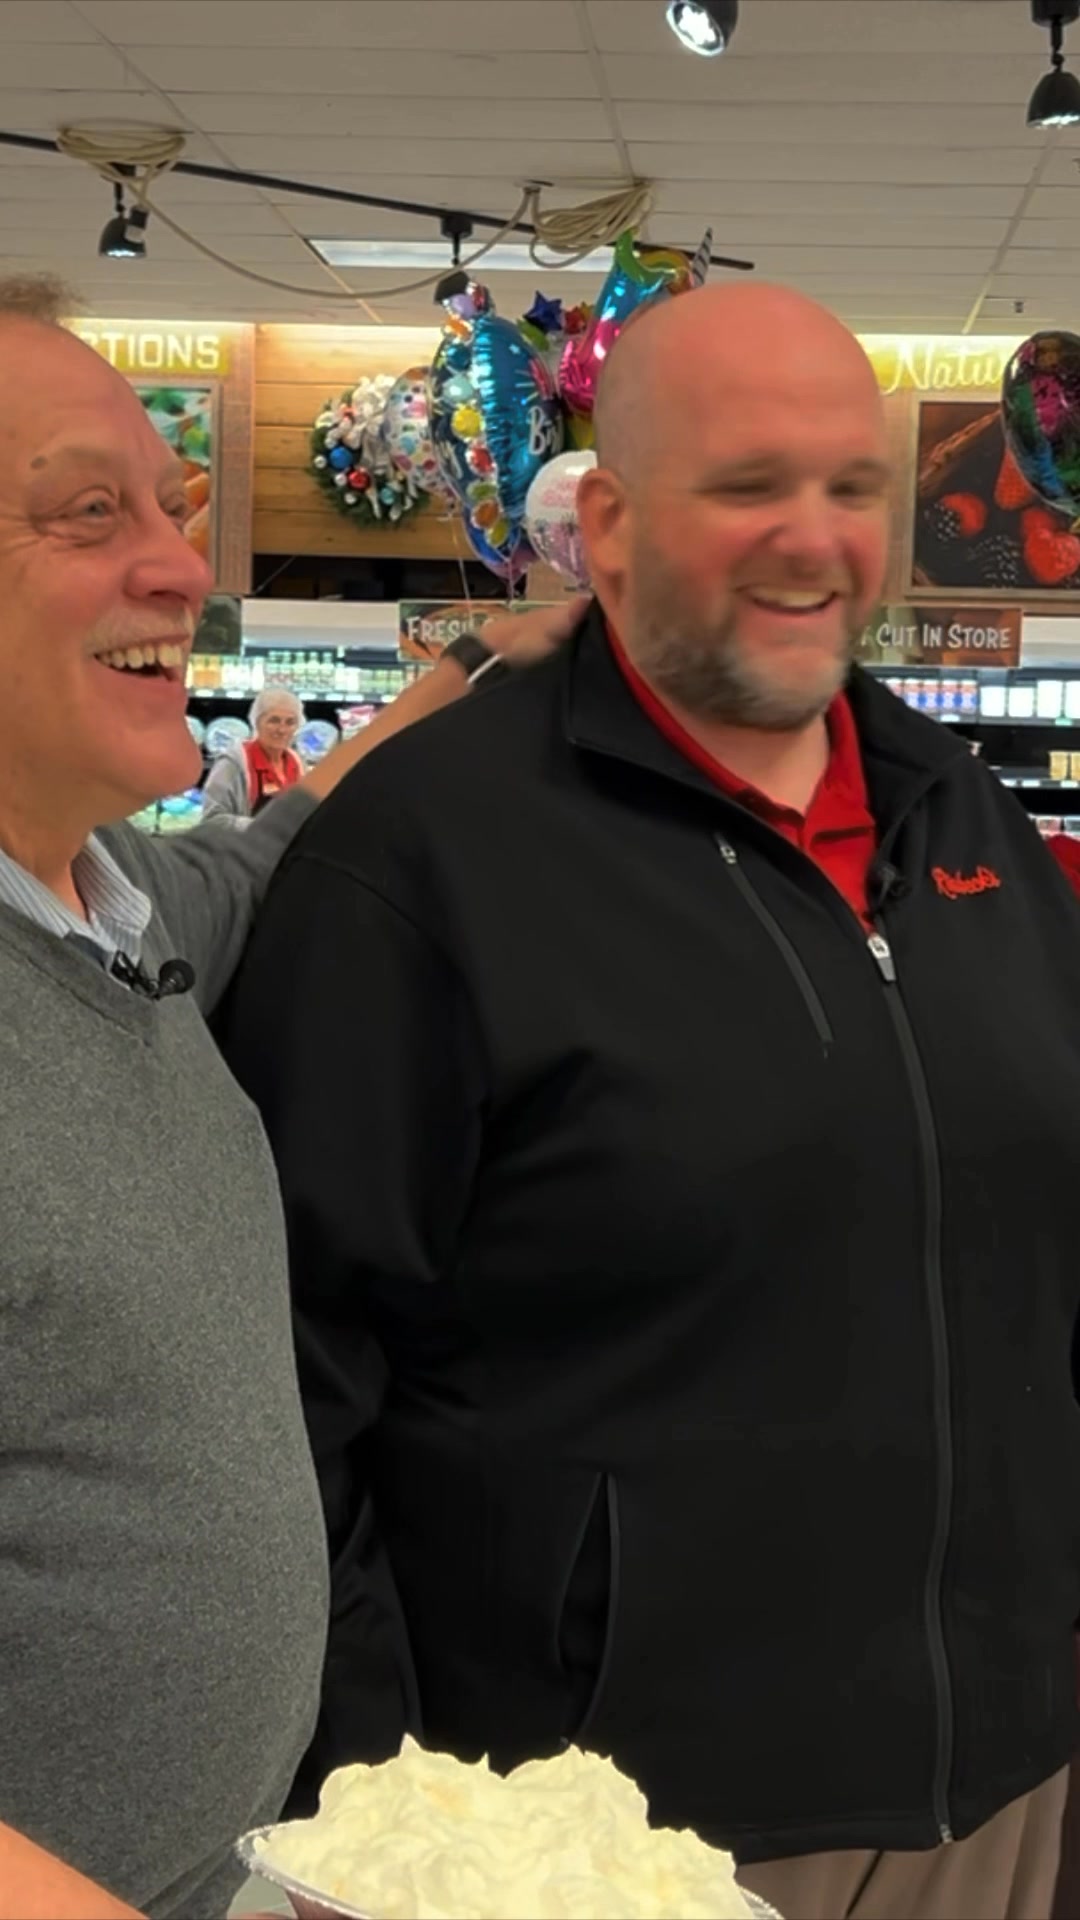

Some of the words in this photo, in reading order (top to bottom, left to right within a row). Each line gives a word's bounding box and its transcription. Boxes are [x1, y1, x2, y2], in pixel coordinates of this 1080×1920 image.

[876, 623, 917, 647] CUT
[923, 624, 943, 647] IN
[947, 624, 1011, 649] STORE
